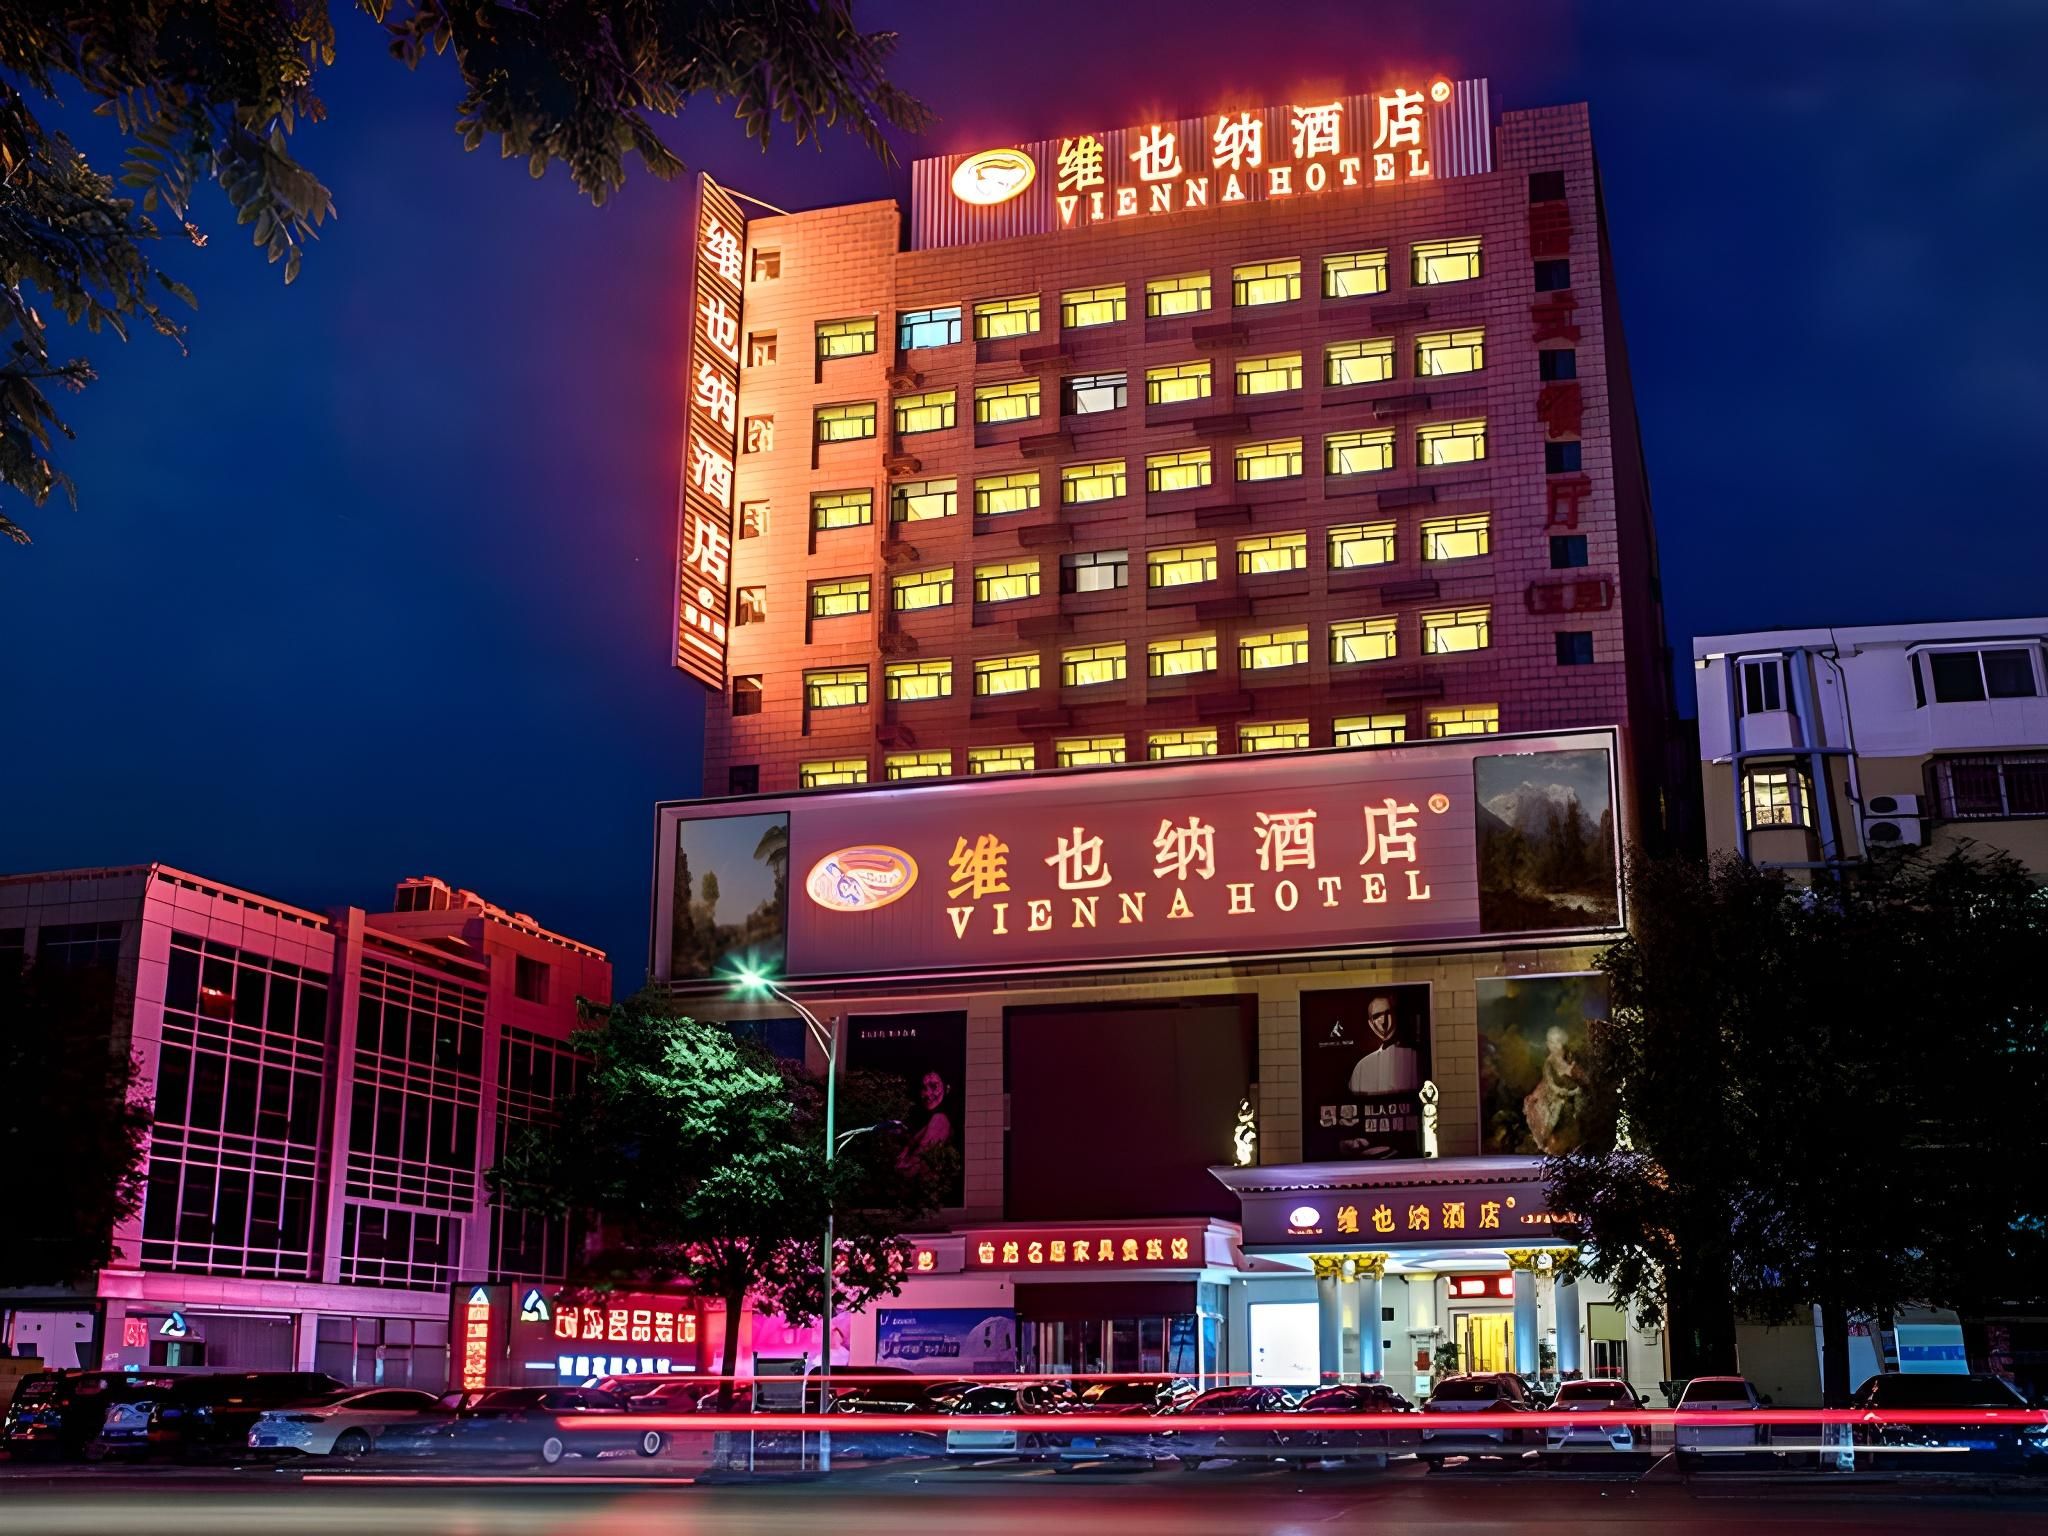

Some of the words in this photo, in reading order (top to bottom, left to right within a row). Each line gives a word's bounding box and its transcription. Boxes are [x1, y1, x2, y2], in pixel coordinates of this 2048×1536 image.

[1057, 88, 1424, 193] 维也纳酒店
[1056, 176, 1245, 225] VIENNA
[1269, 149, 1431, 197] HOTEL
[687, 214, 742, 585] 维也纳酒店
[947, 798, 1420, 900] 维也纳酒店
[946, 887, 1194, 939] VIENNA
[1226, 870, 1431, 915] HOTEL
[1337, 1202, 1500, 1234] 维也纳酒店
